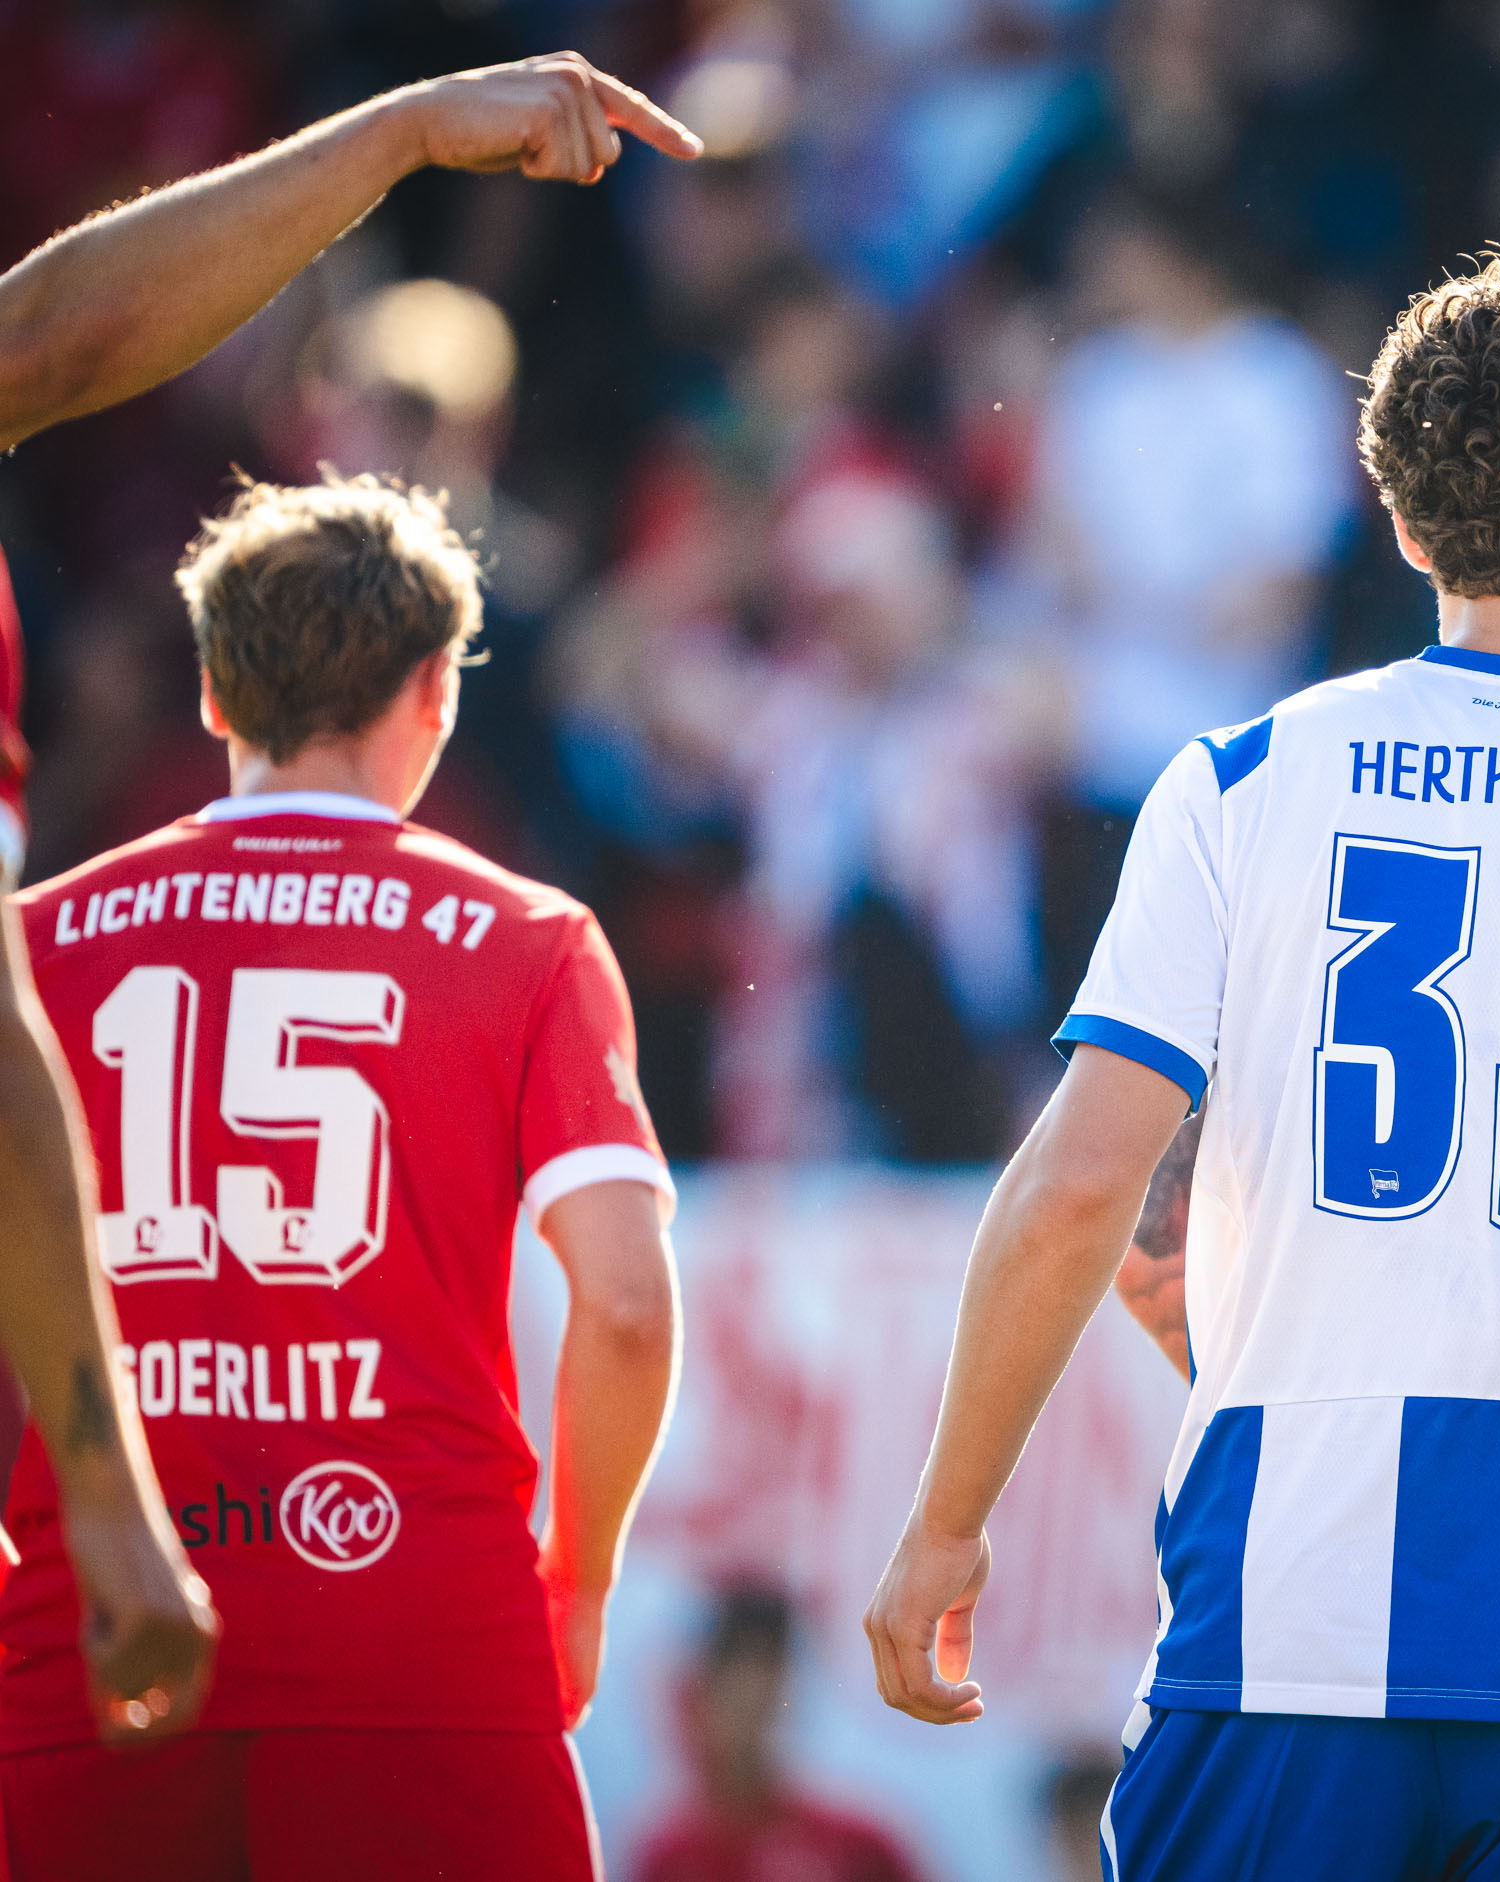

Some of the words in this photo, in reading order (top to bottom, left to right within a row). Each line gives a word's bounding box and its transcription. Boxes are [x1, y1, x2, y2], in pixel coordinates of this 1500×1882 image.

[54, 872, 411, 946] LICHTENBERG
[422, 895, 497, 951] 47
[92, 964, 407, 1287] 15
[172, 1482, 273, 1549] shi
[299, 1480, 398, 1560] Koo
